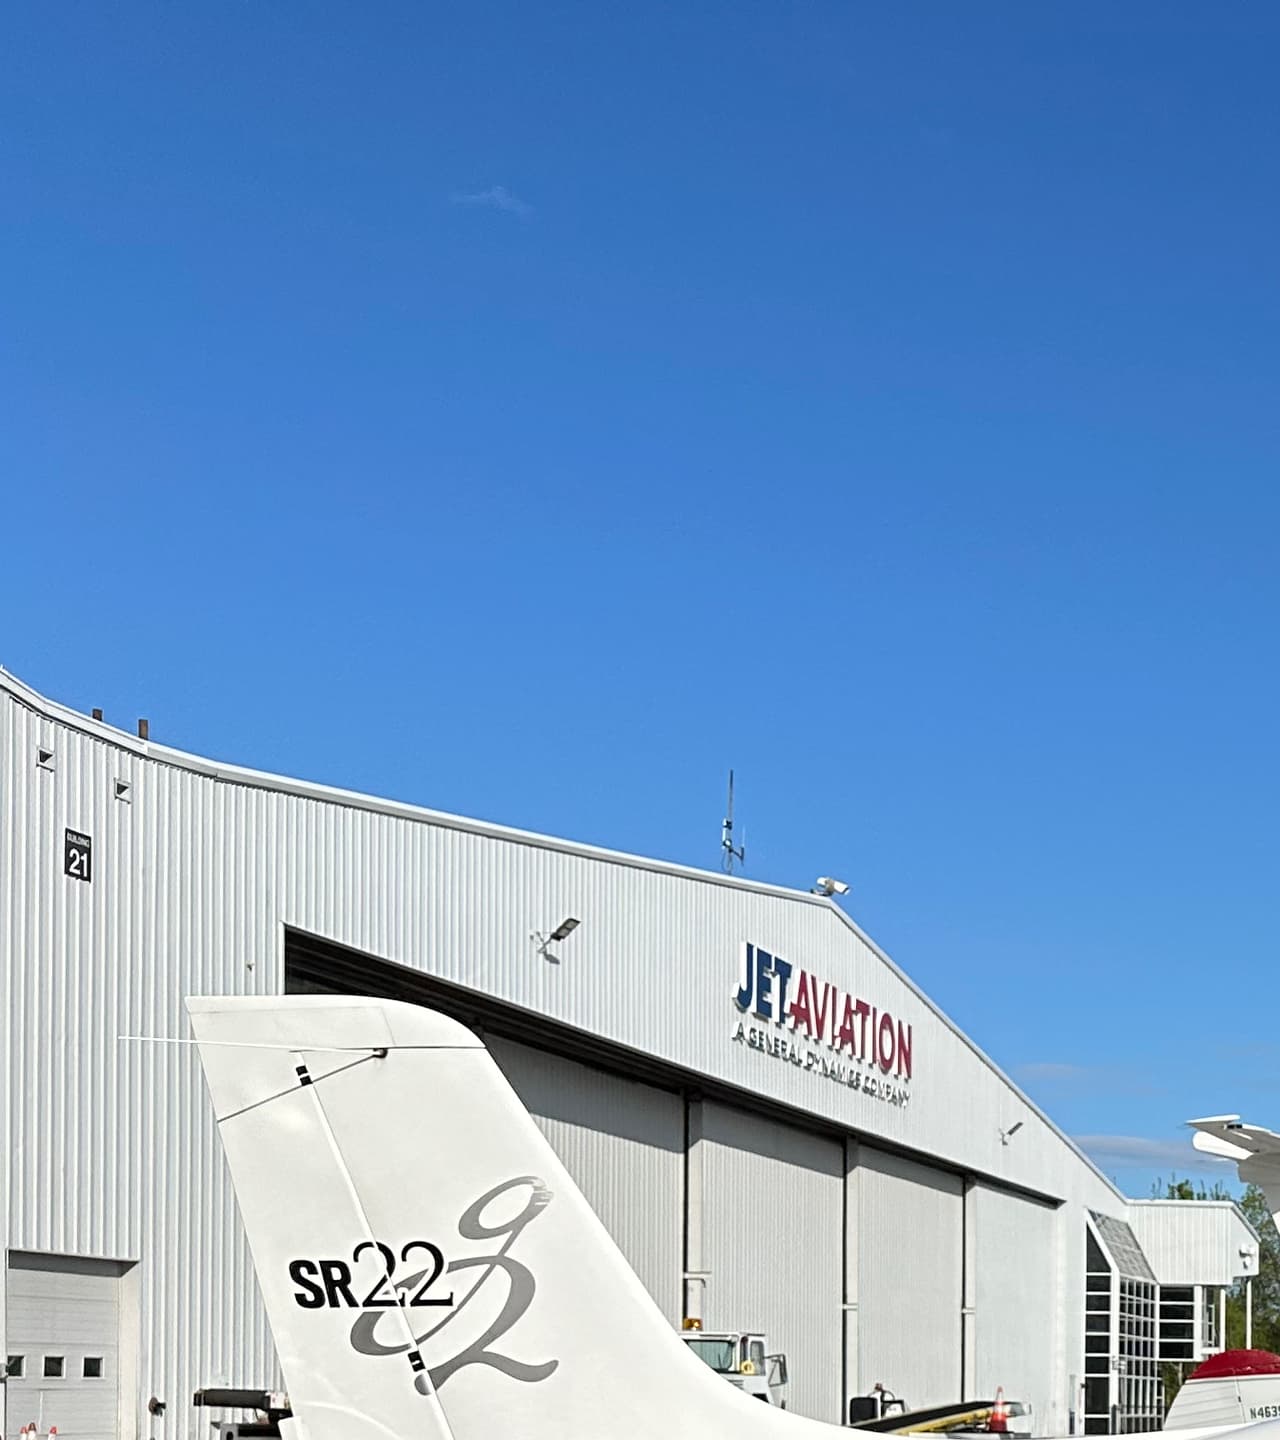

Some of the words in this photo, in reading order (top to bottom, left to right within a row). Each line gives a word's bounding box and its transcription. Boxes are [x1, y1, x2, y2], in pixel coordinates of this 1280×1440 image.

[69, 848, 88, 877] 21
[735, 941, 793, 1026] JET
[788, 969, 913, 1080] AVIATION
[735, 1021, 746, 1042] A
[749, 1027, 801, 1066] GENERAL
[862, 1074, 911, 1107] COMPANY
[288, 1240, 454, 1309] SR22
